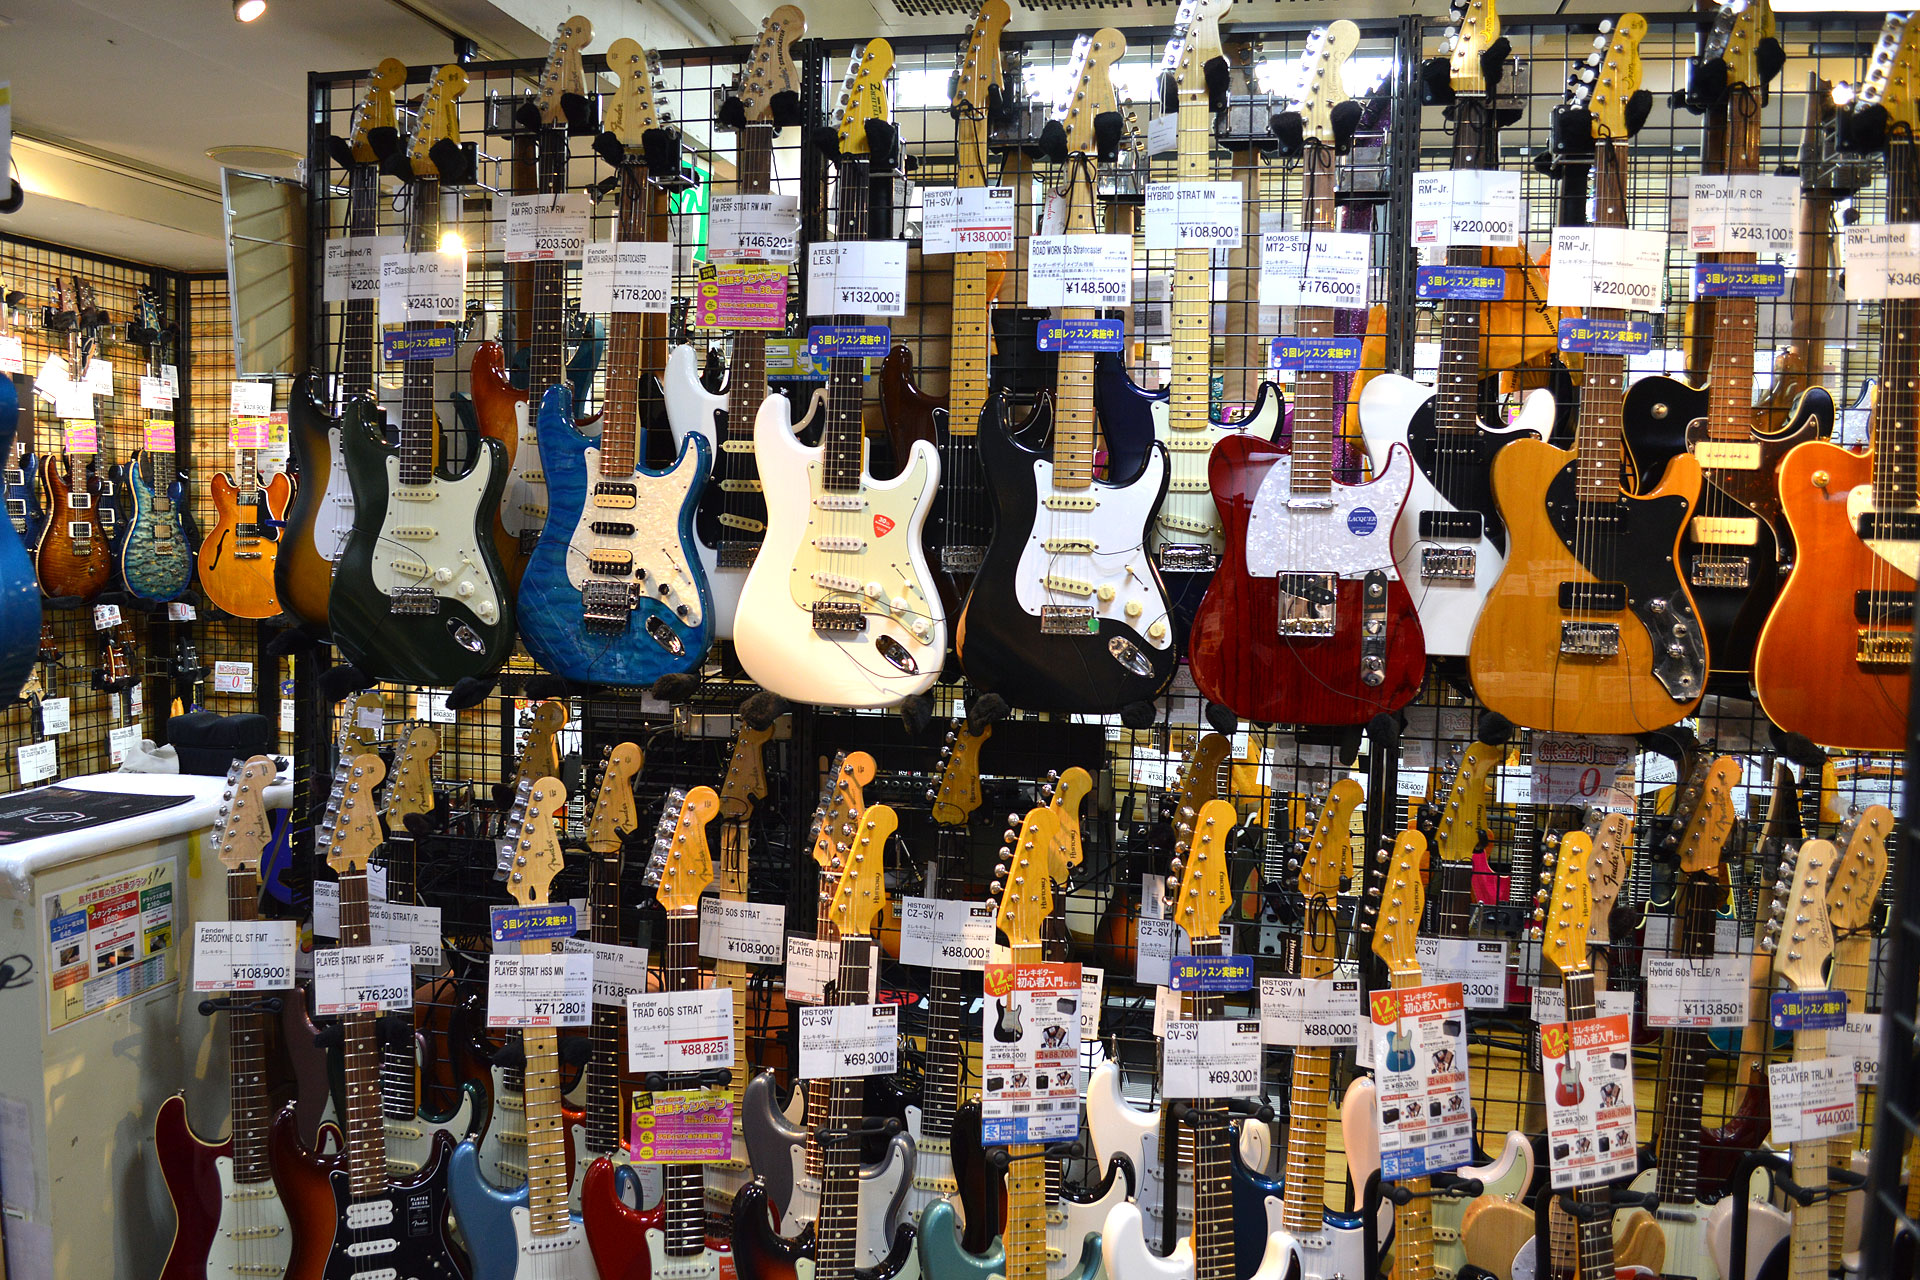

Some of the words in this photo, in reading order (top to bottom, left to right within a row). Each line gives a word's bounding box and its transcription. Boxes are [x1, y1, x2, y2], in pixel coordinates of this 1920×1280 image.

[612, 103, 624, 131] Fender
[1147, 191, 1174, 200] HYBRID
[1177, 191, 1201, 200] STRAT
[1203, 190, 1215, 199] MN
[1419, 185, 1448, 194] RM-Jr.
[1750, 190, 1762, 198] CR
[925, 198, 963, 207] TH-SV/M
[512, 208, 518, 216] AM
[556, 206, 564, 214] RW
[1181, 226, 1233, 238] ¥108,900
[1453, 220, 1508, 233] ¥220,000
[960, 231, 1006, 243] ¥138,000
[1732, 227, 1787, 240] ¥243,100
[1848, 234, 1904, 244] RM-Limited
[535, 238, 580, 249] ¥203,500
[739, 237, 787, 247] ¥146,520
[1558, 241, 1590, 252] RM-Jr.
[1033, 246, 1045, 255] ROAD
[1047, 246, 1061, 255] WORN
[384, 264, 438, 276] ST-Classic/R/CR
[1066, 282, 1120, 294] ¥148,500
[1299, 281, 1354, 294] ¥176,000
[1594, 281, 1650, 297] ¥220,000
[613, 289, 661, 300] ¥178,200
[842, 292, 894, 303] ¥132,000
[408, 298, 454, 310] ¥243,100
[1614, 818, 1624, 851] TELECASTER
[393, 912, 418, 922] STRAT/R
[703, 905, 723, 914] HYBRID
[726, 909, 738, 918] 50S
[740, 910, 760, 919] STRAT
[908, 909, 944, 920] CZ-SV/R
[201, 934, 233, 942] AERODYNE
[236, 934, 243, 942] CL
[246, 934, 253, 942] ST
[255, 934, 267, 942] FMT
[728, 941, 775, 955] ¥108,900
[789, 945, 813, 957] PLAYER
[816, 949, 838, 960] STRAT
[942, 947, 984, 958] ¥88,000
[316, 957, 339, 966] PLAYER
[342, 956, 361, 965] STRAT
[377, 954, 384, 962] PF
[596, 953, 623, 962] STRAT/R
[233, 968, 284, 978] ¥108,900
[495, 967, 517, 975] PLAYER
[520, 967, 538, 975] STRAT
[541, 967, 552, 975] HSS
[1650, 968, 1672, 977] Hybrid
[1675, 968, 1690, 976] 60s
[1693, 968, 1720, 976] TELE/R
[1017, 977, 1063, 988] 初心者入門
[358, 988, 402, 1001] ¥76,230
[1262, 987, 1305, 997] CZ-SV/M
[1404, 992, 1438, 1001] エレキギター
[1534, 996, 1551, 1005] TRAD
[535, 1003, 579, 1015] ¥71,280
[633, 1008, 654, 1018] TRAD
[658, 1007, 674, 1017] 60S
[678, 1005, 703, 1016] STRAT
[1404, 999, 1447, 1014] 初心者入門
[1685, 1004, 1737, 1015] ¥113,850
[802, 1017, 832, 1026] CV-SV
[1305, 1024, 1351, 1035] ¥88,000
[1572, 1024, 1606, 1034] エレキギター
[1167, 1031, 1198, 1040] CV-SV
[1573, 1032, 1614, 1047] 初心者入門
[681, 1042, 724, 1055] ¥88,825
[844, 1052, 888, 1066] ¥69,300
[1209, 1070, 1252, 1083] ¥69,300
[1771, 1073, 1810, 1085] G-PLAYER
[1812, 1068, 1833, 1081] TRL/M
[1816, 1110, 1850, 1125] ¥44,000
